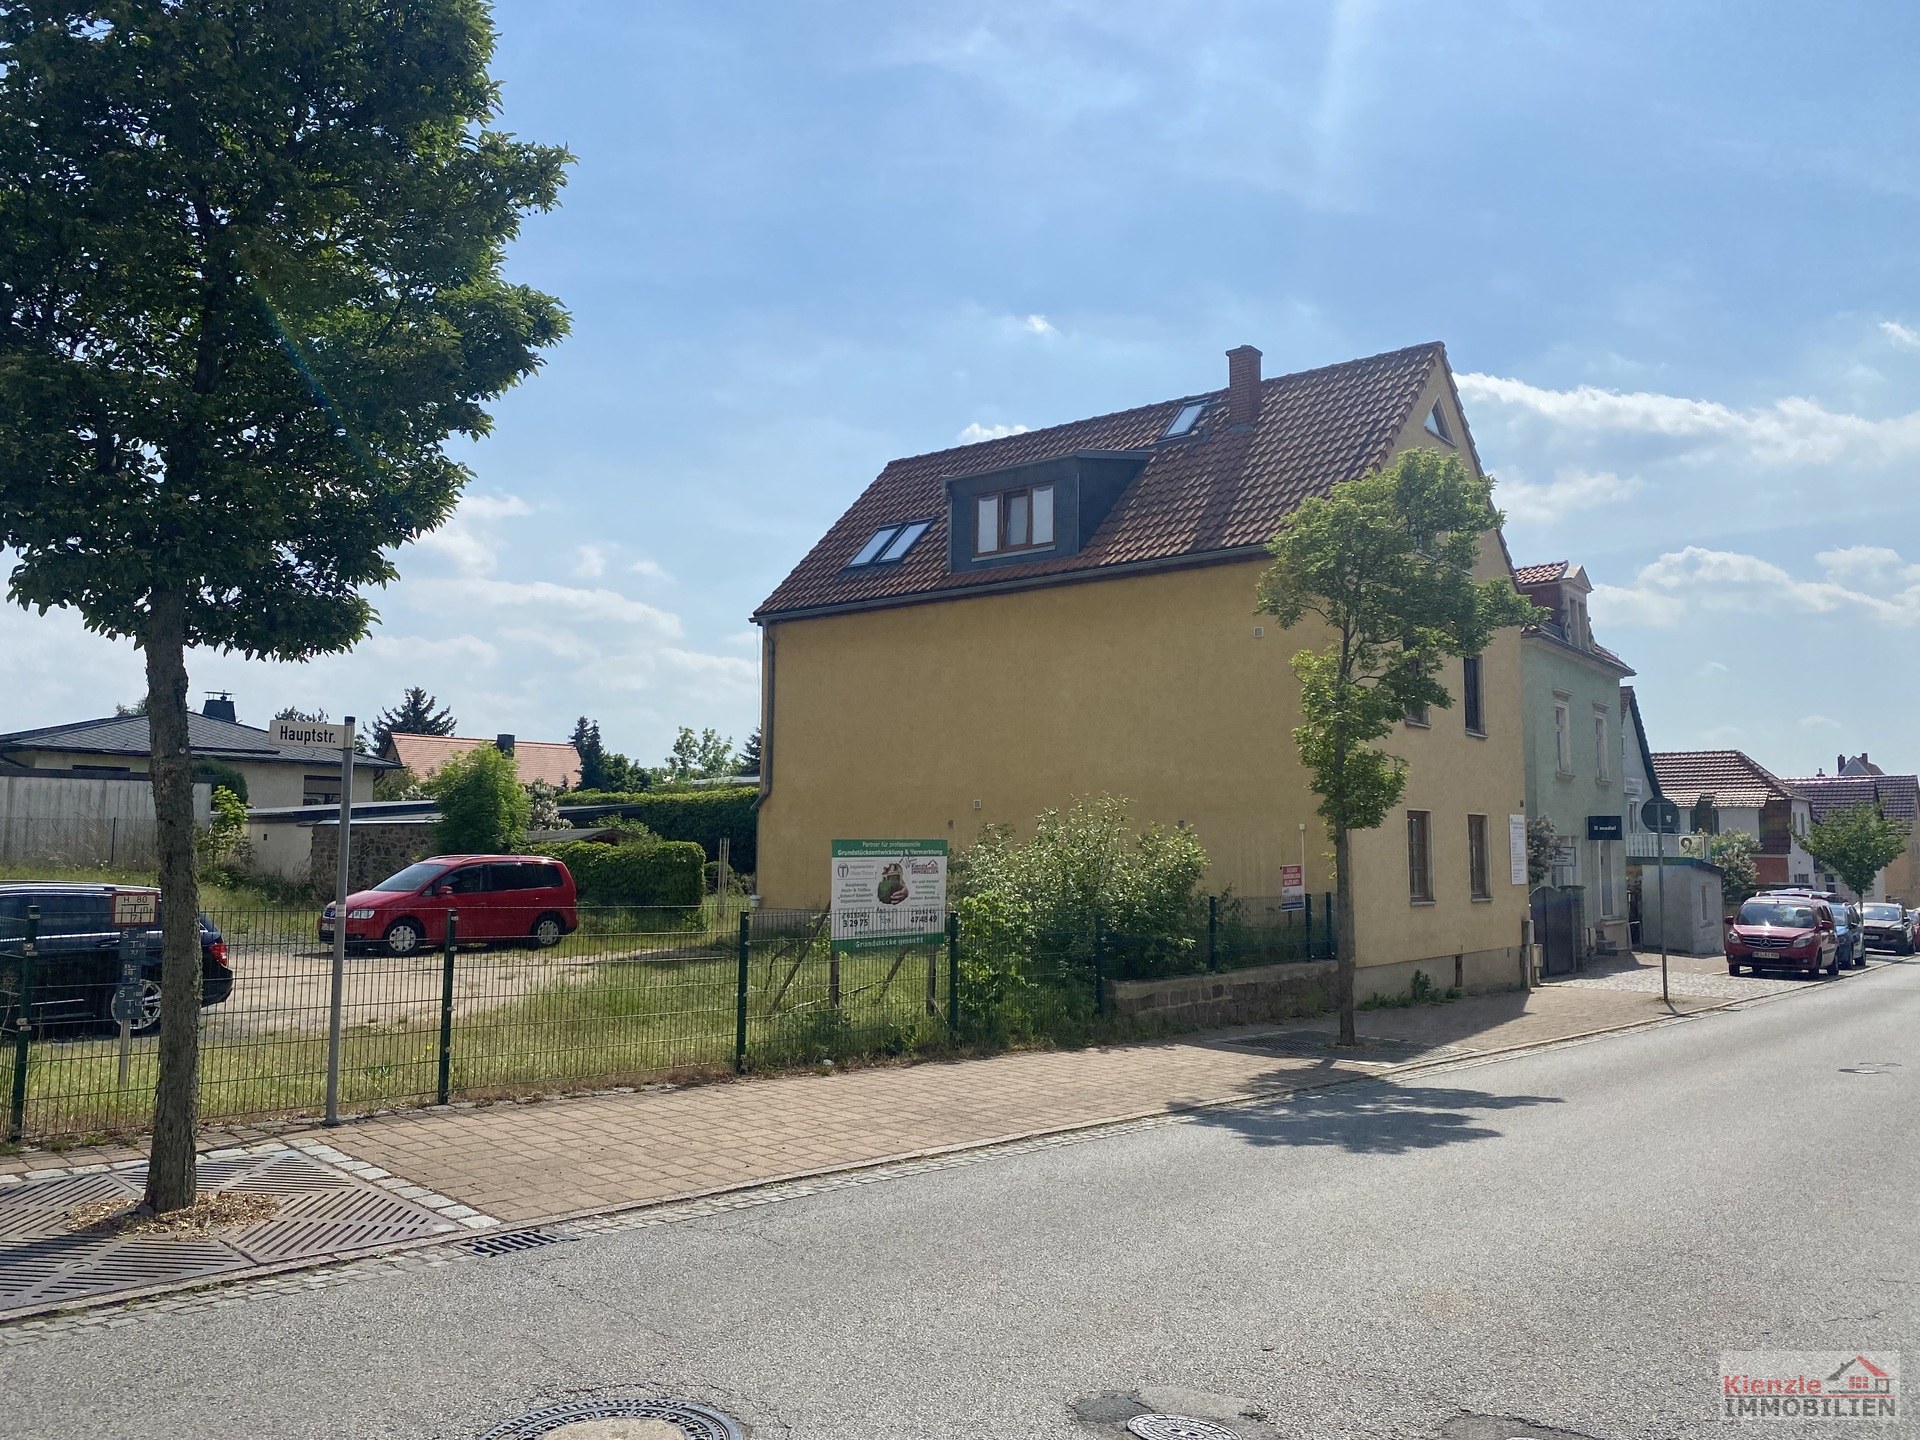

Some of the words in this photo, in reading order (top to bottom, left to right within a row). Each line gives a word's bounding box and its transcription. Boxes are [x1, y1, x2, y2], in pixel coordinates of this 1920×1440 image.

[280, 725, 336, 745] Hauptstr.
[837, 849, 904, 857] Grundstücksentwicklung
[910, 849, 943, 857] Vermarktung
[123, 896, 130, 904] H
[136, 895, 148, 904] 80
[849, 919, 859, 928] 29
[859, 919, 869, 927] 75
[122, 930, 129, 939] S
[119, 989, 126, 998] S
